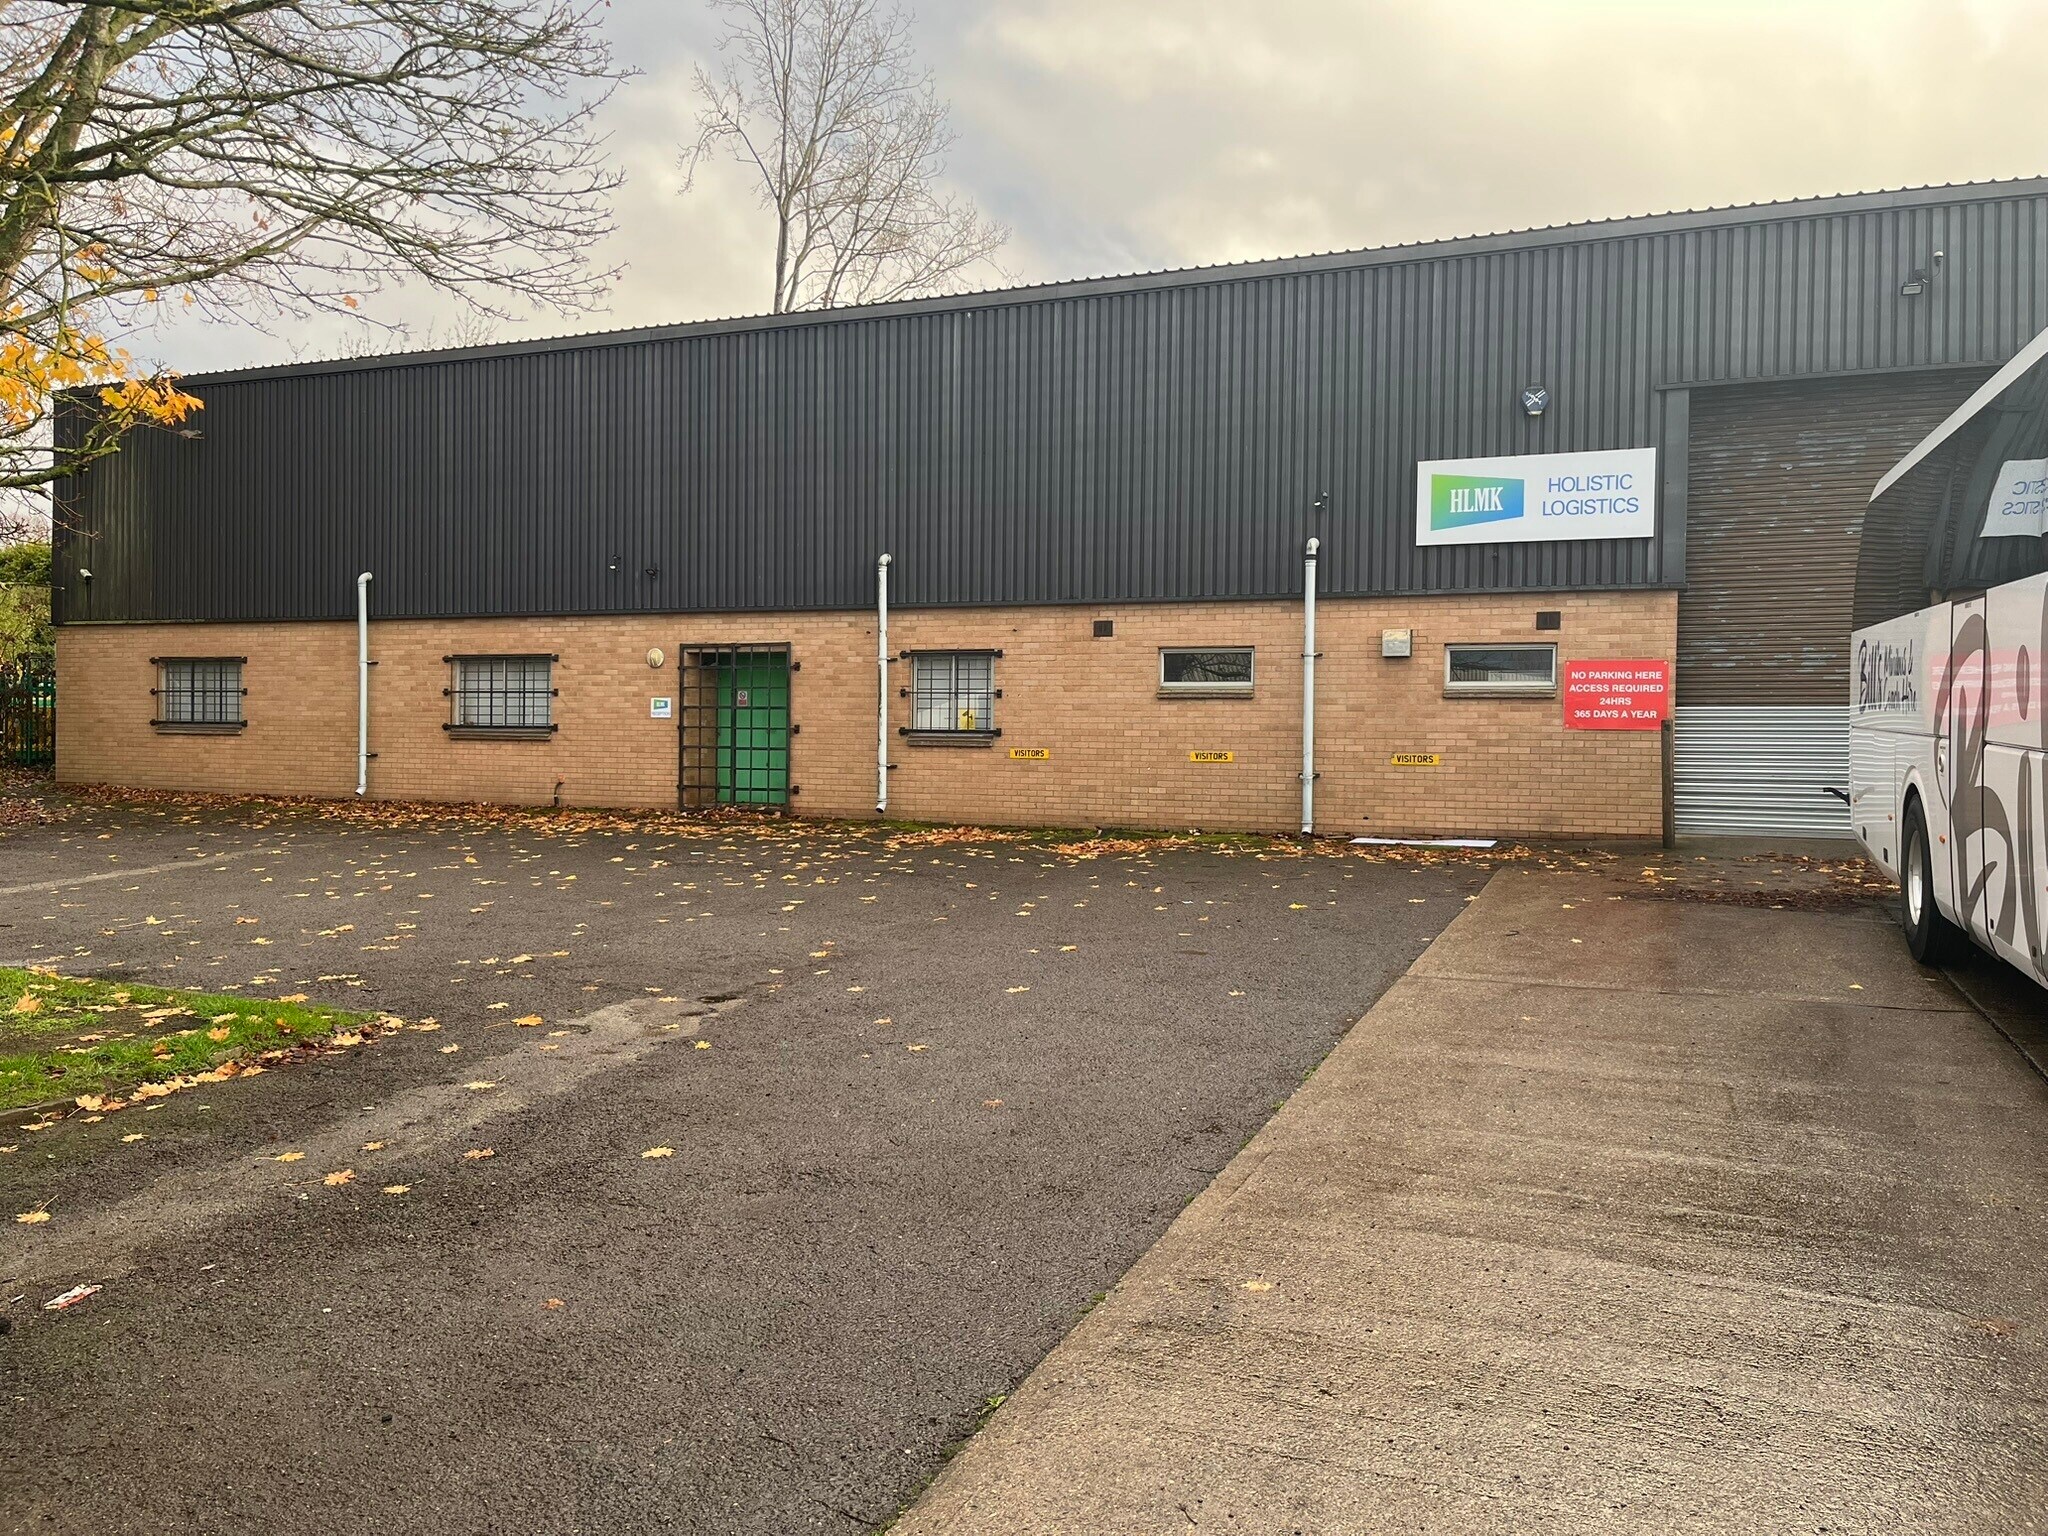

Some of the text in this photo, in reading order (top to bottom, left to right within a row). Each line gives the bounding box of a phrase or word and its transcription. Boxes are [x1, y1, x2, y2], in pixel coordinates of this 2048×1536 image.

[1548, 474, 1633, 493] HOLISTIC
[1449, 486, 1504, 513] HLMK
[1542, 496, 1639, 516] LOGISTICS
[1571, 671, 1662, 680] NO PARKING HERE
[1569, 684, 1663, 693] ACCESS REQUIRED
[1599, 697, 1632, 706] 24HRS
[1574, 710, 1657, 719] 365 DAYS A YEAR
[1014, 749, 1045, 757] VISITORS
[1195, 752, 1228, 760] VISITORS
[1396, 754, 1434, 763] VISITORS
